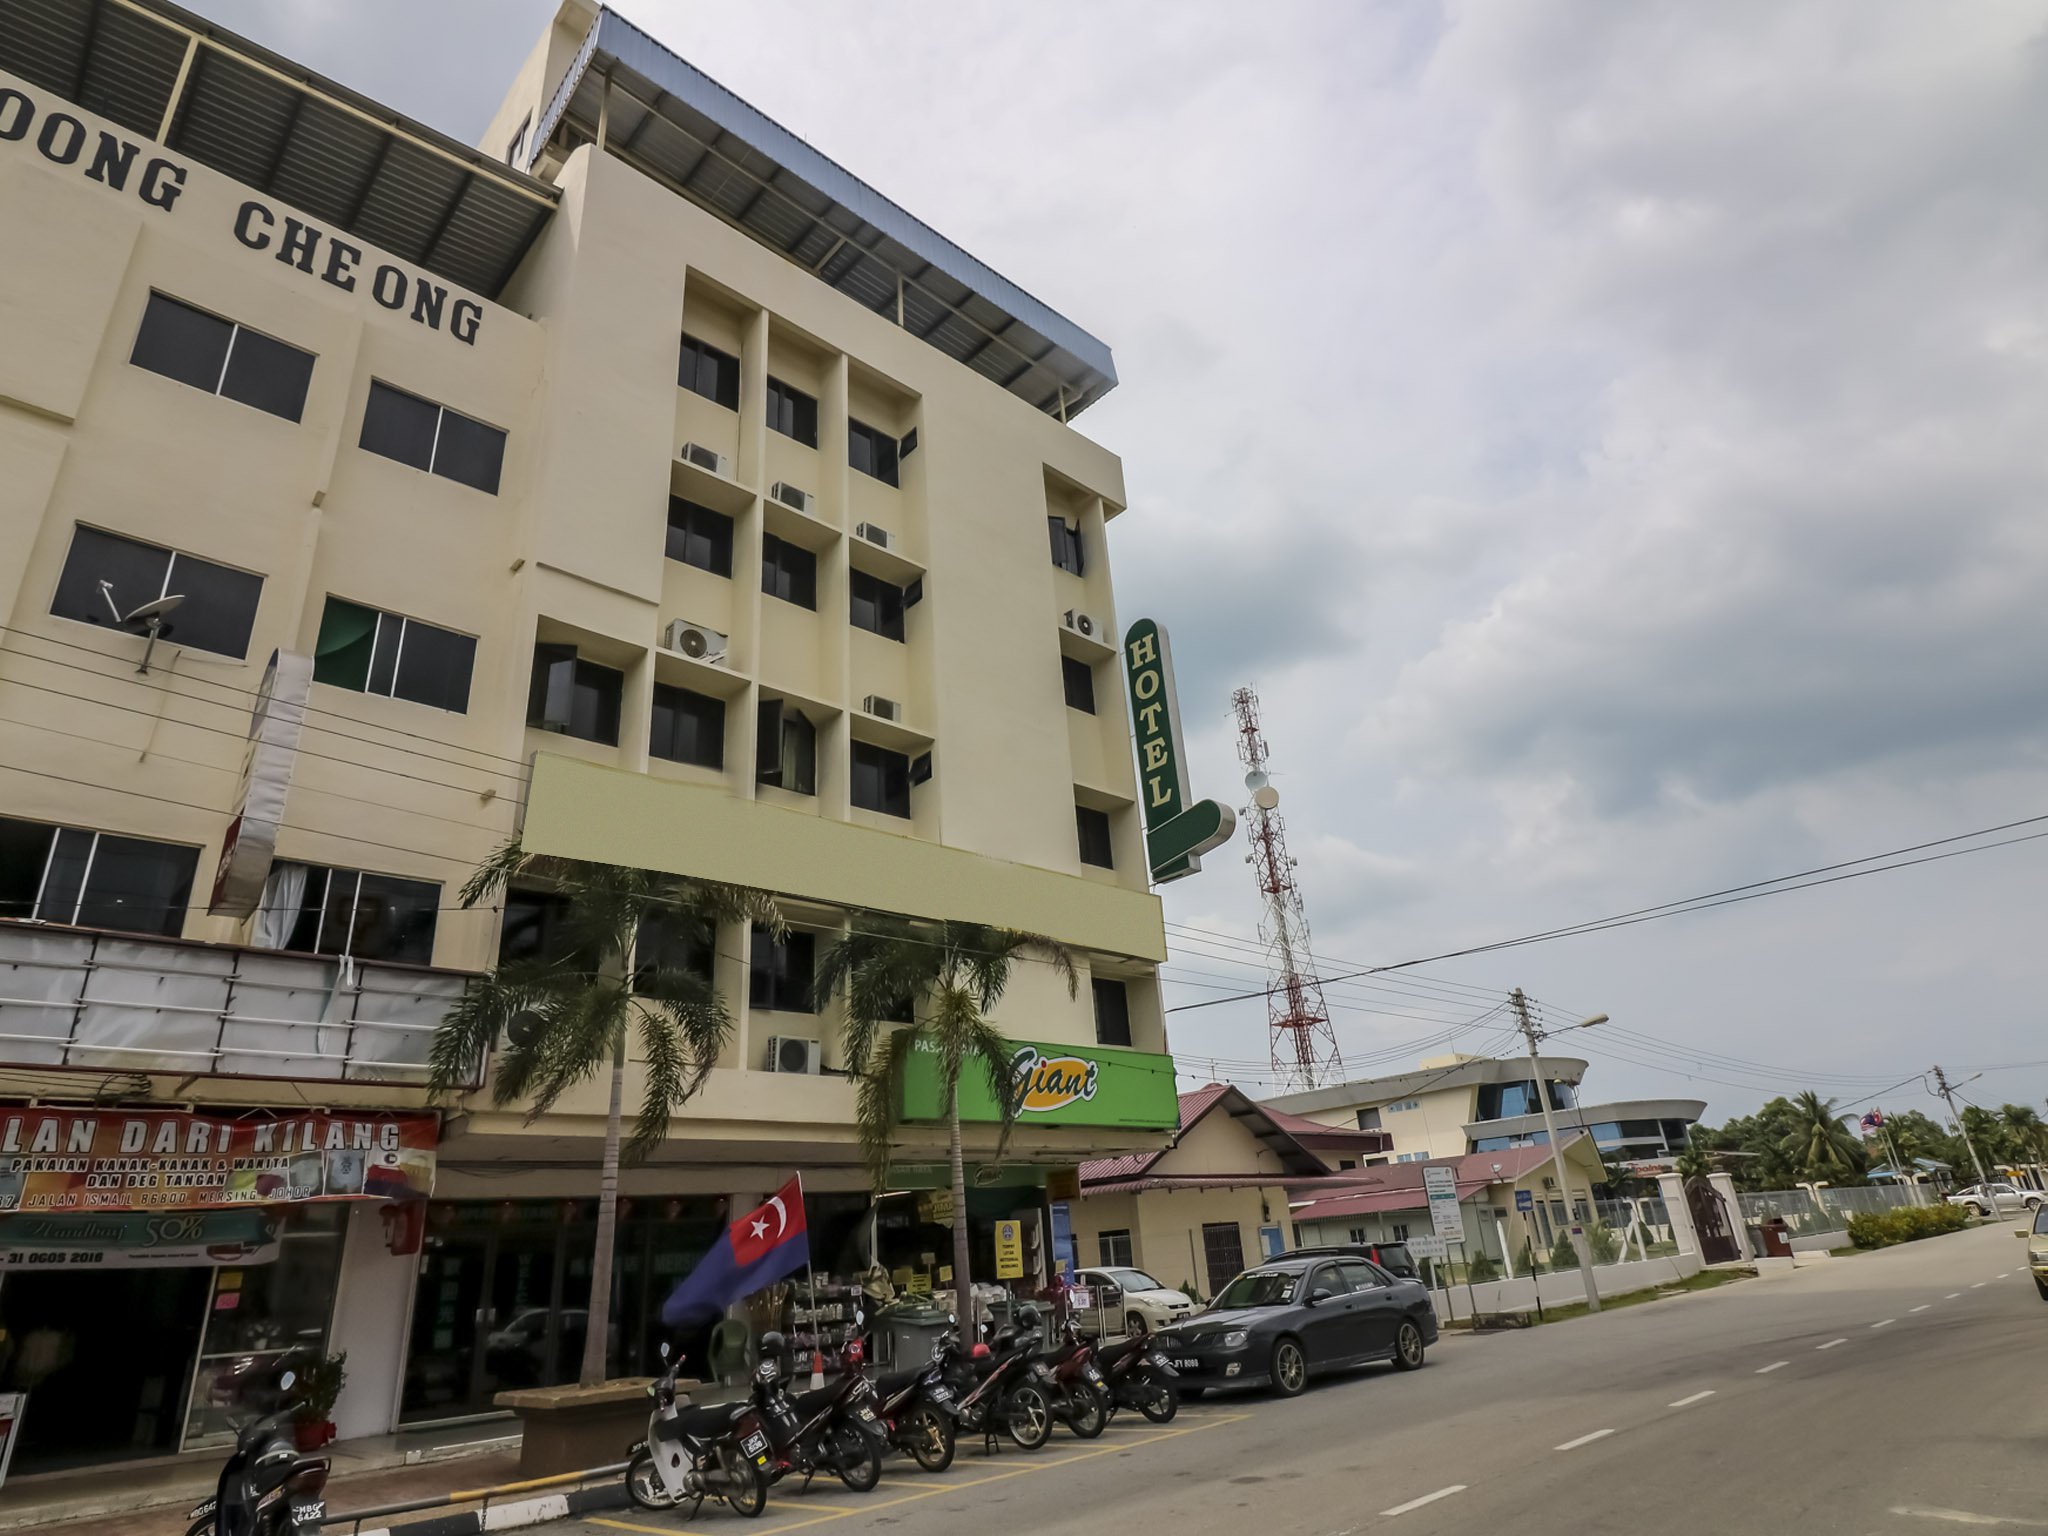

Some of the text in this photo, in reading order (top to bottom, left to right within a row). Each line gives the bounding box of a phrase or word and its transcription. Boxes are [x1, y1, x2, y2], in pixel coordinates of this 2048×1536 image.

[0, 87, 483, 346] OONG CHEONG
[1129, 633, 1172, 808] HOTEL
[1010, 1049, 1096, 1115] Giant
[2, 1117, 400, 1154] LAN DARI KILANG
[10, 1157, 289, 1172] PAKAIAN KANAK-KANAK & WANITA
[86, 1172, 226, 1188] DAN BEG TANGAN
[27, 1193, 78, 1207] JALAN
[83, 1191, 133, 1206] ISMAIL
[199, 1189, 257, 1203] MERSING
[269, 1186, 311, 1199] JOHOR
[142, 1216, 205, 1247] 50%
[8, 1252, 24, 1264] 31
[28, 1252, 66, 1264] OGOS
